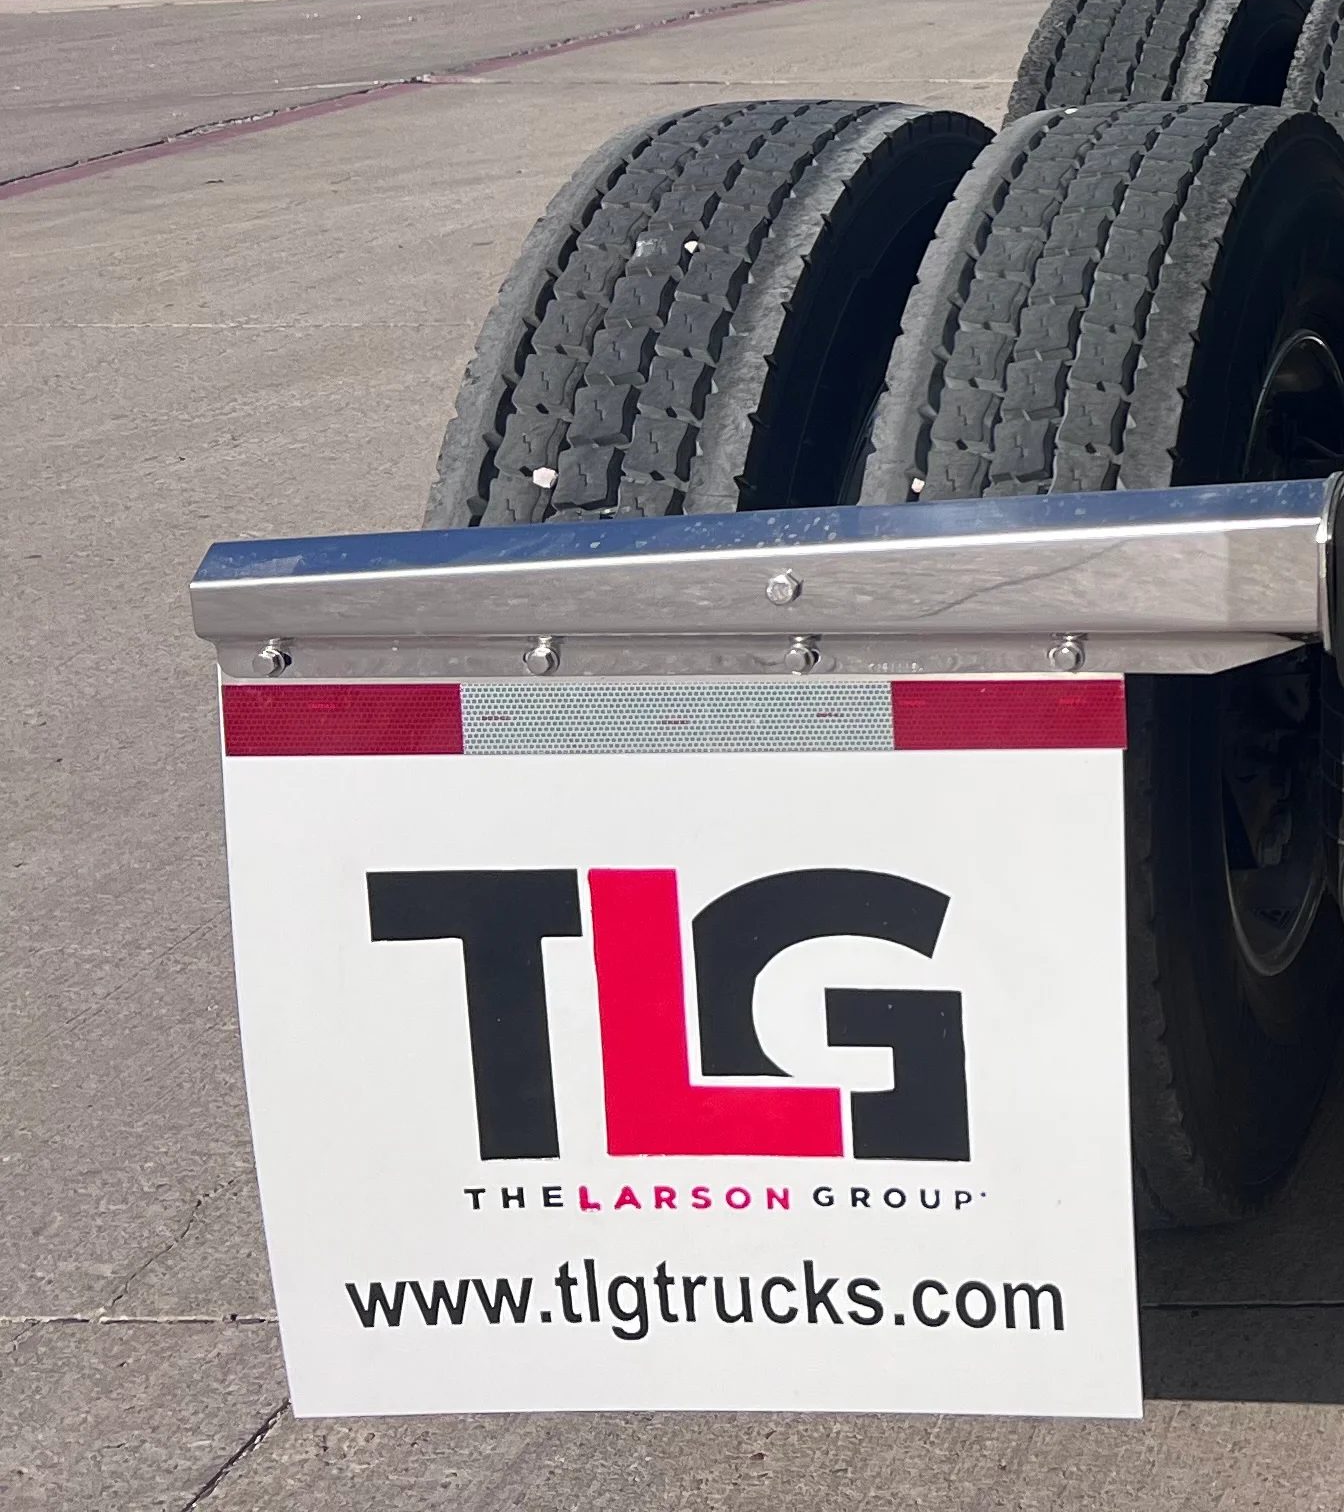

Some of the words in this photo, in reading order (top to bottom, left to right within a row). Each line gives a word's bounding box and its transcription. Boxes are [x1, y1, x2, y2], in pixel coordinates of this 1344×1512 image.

[366, 869, 970, 1161] TLG
[813, 1186, 971, 1211] GROUP
[346, 1259, 1064, 1341] www.tlgtrucks.com
